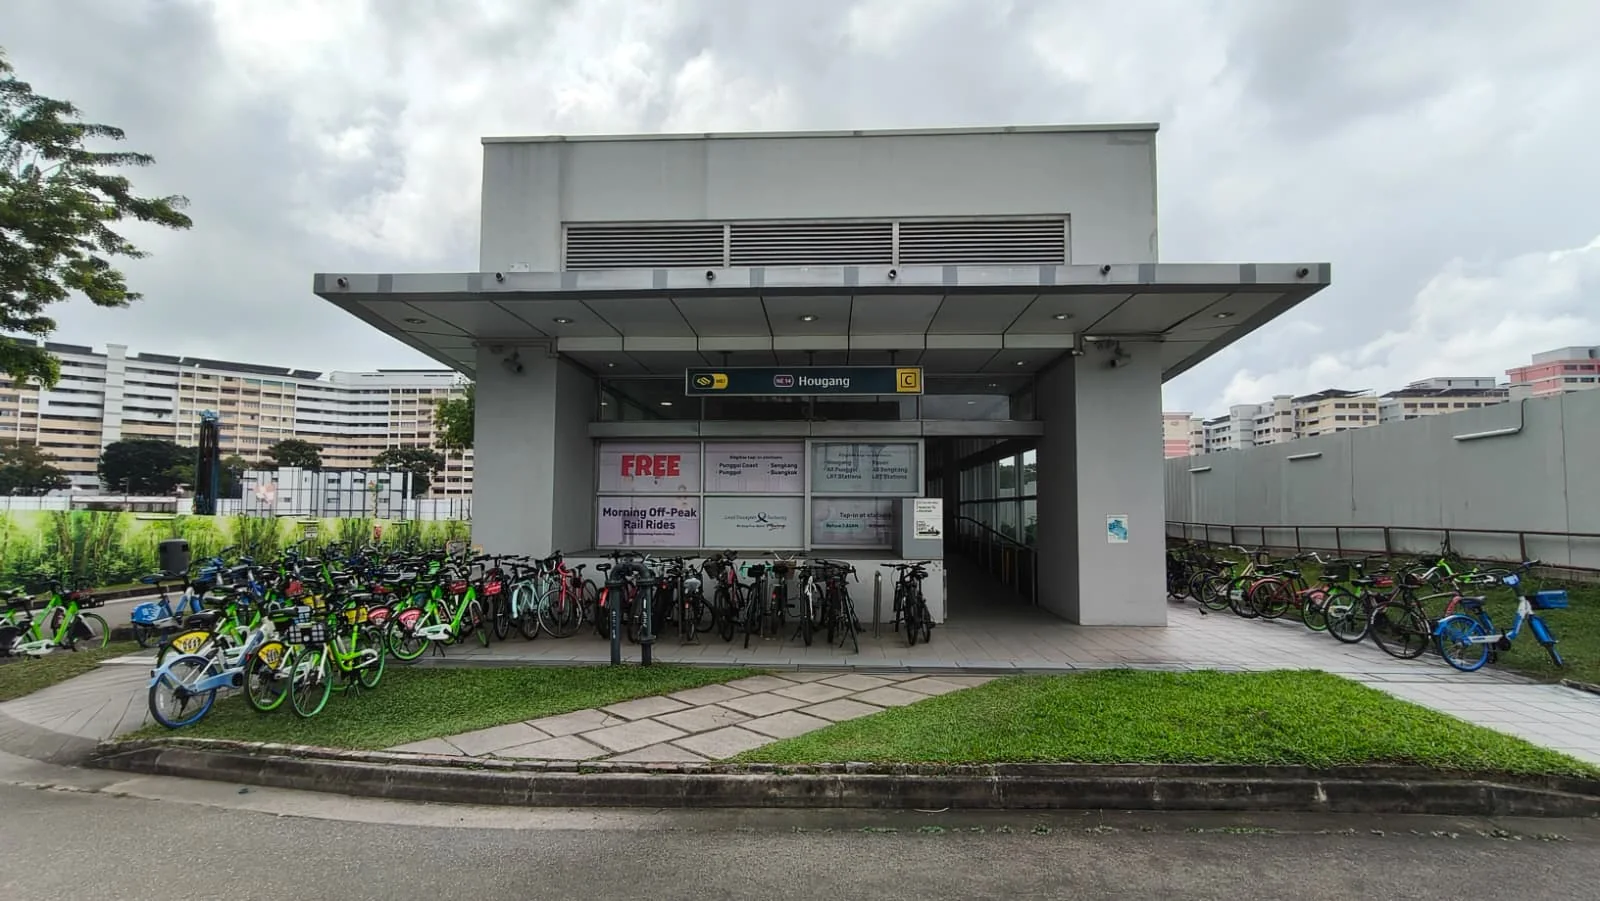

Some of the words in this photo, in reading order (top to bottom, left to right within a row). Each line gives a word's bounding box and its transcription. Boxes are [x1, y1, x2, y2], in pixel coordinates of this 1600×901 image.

[799, 376, 850, 387] Hougang
[904, 375, 913, 385] C
[621, 454, 681, 477] FREE
[602, 507, 647, 519] Morning
[649, 507, 697, 517] Off-Peak
[623, 519, 643, 529] Rail
[645, 519, 676, 529] Rides
